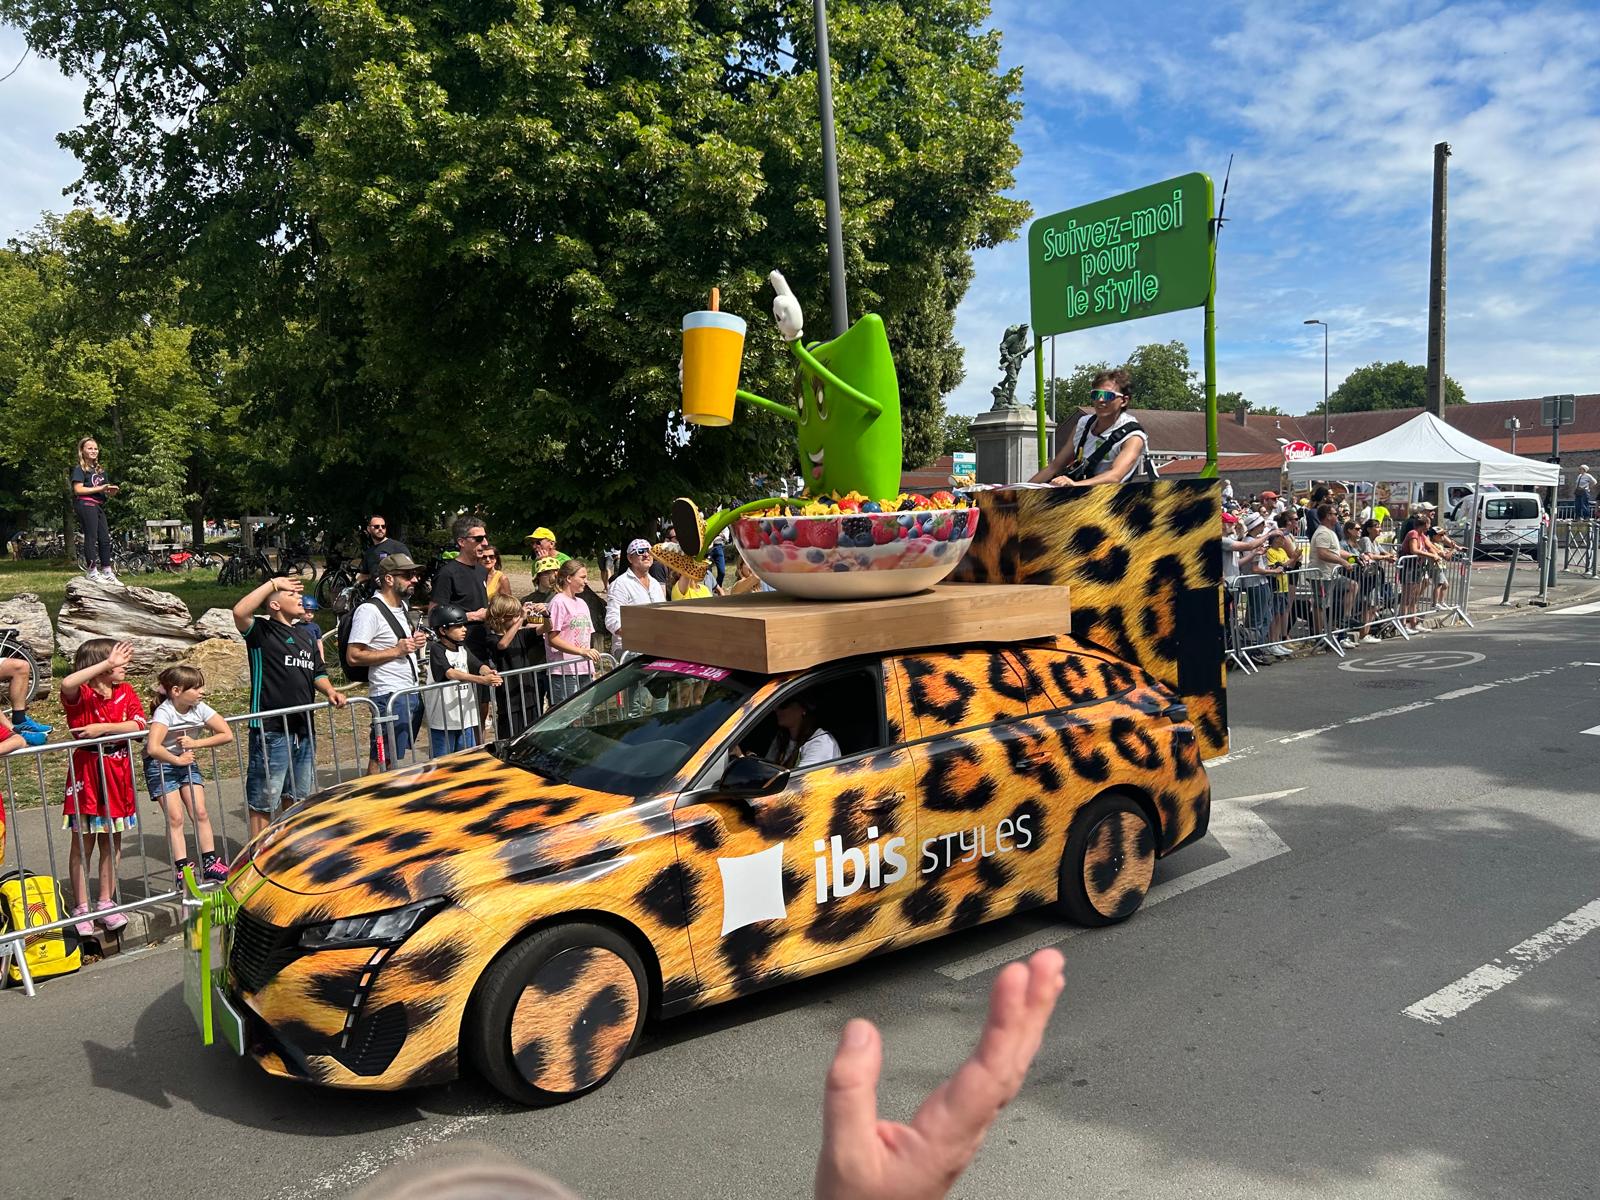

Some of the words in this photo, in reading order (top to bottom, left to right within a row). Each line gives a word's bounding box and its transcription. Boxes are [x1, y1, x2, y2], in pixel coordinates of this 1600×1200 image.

[1043, 189, 1182, 261] Suivez-moi
[1067, 286, 1089, 318] le
[1094, 270, 1159, 313] style
[1081, 242, 1140, 286] pour
[814, 825, 908, 904] ibis
